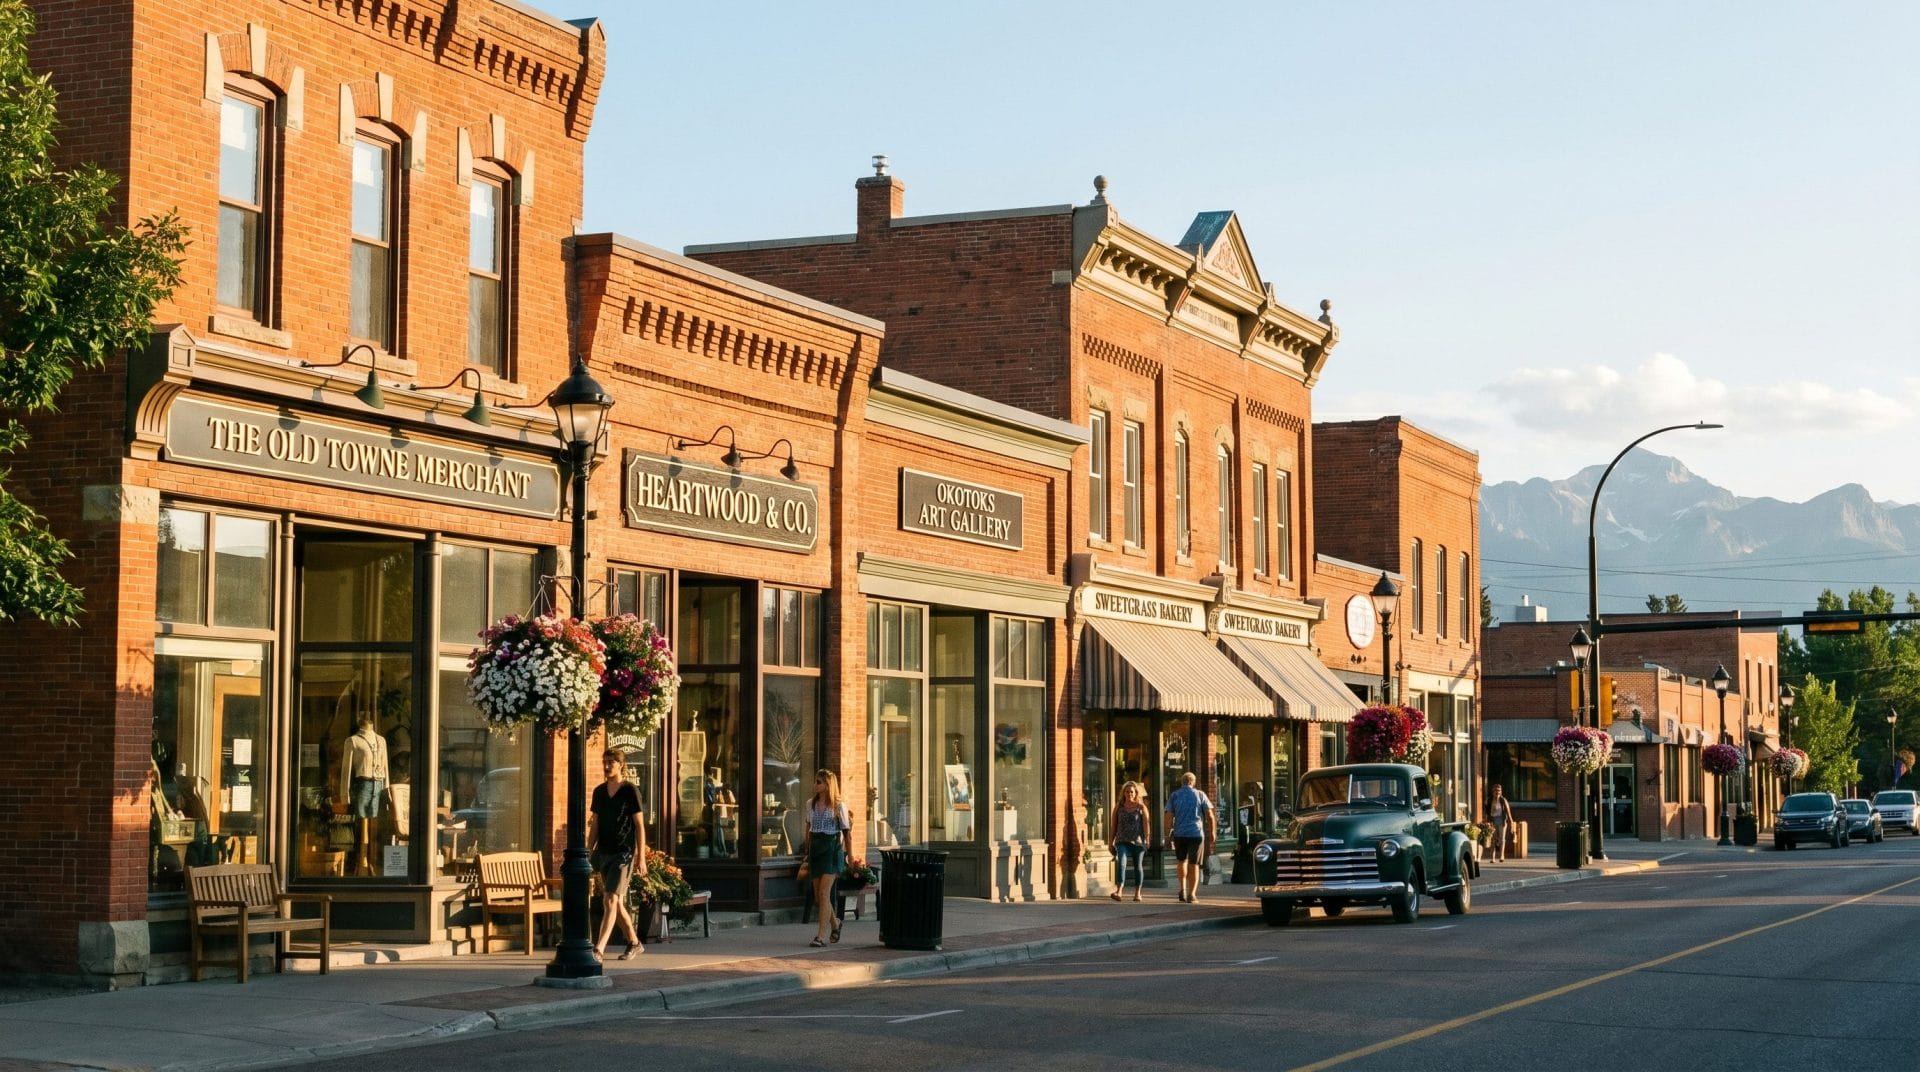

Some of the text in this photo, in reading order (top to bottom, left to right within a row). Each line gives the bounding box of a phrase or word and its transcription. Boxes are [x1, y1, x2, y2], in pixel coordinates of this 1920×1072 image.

[207, 417, 531, 499] THE OLD TOWNE MERCHANT
[637, 471, 812, 534] HEARTWOOD & CO.
[937, 482, 995, 513] OKOTOKS
[919, 503, 1011, 540] ART GALLERY
[1095, 592, 1193, 623] SWEETGRASS BAKERY
[1224, 613, 1302, 639] SWEETGRASS BAKERY
